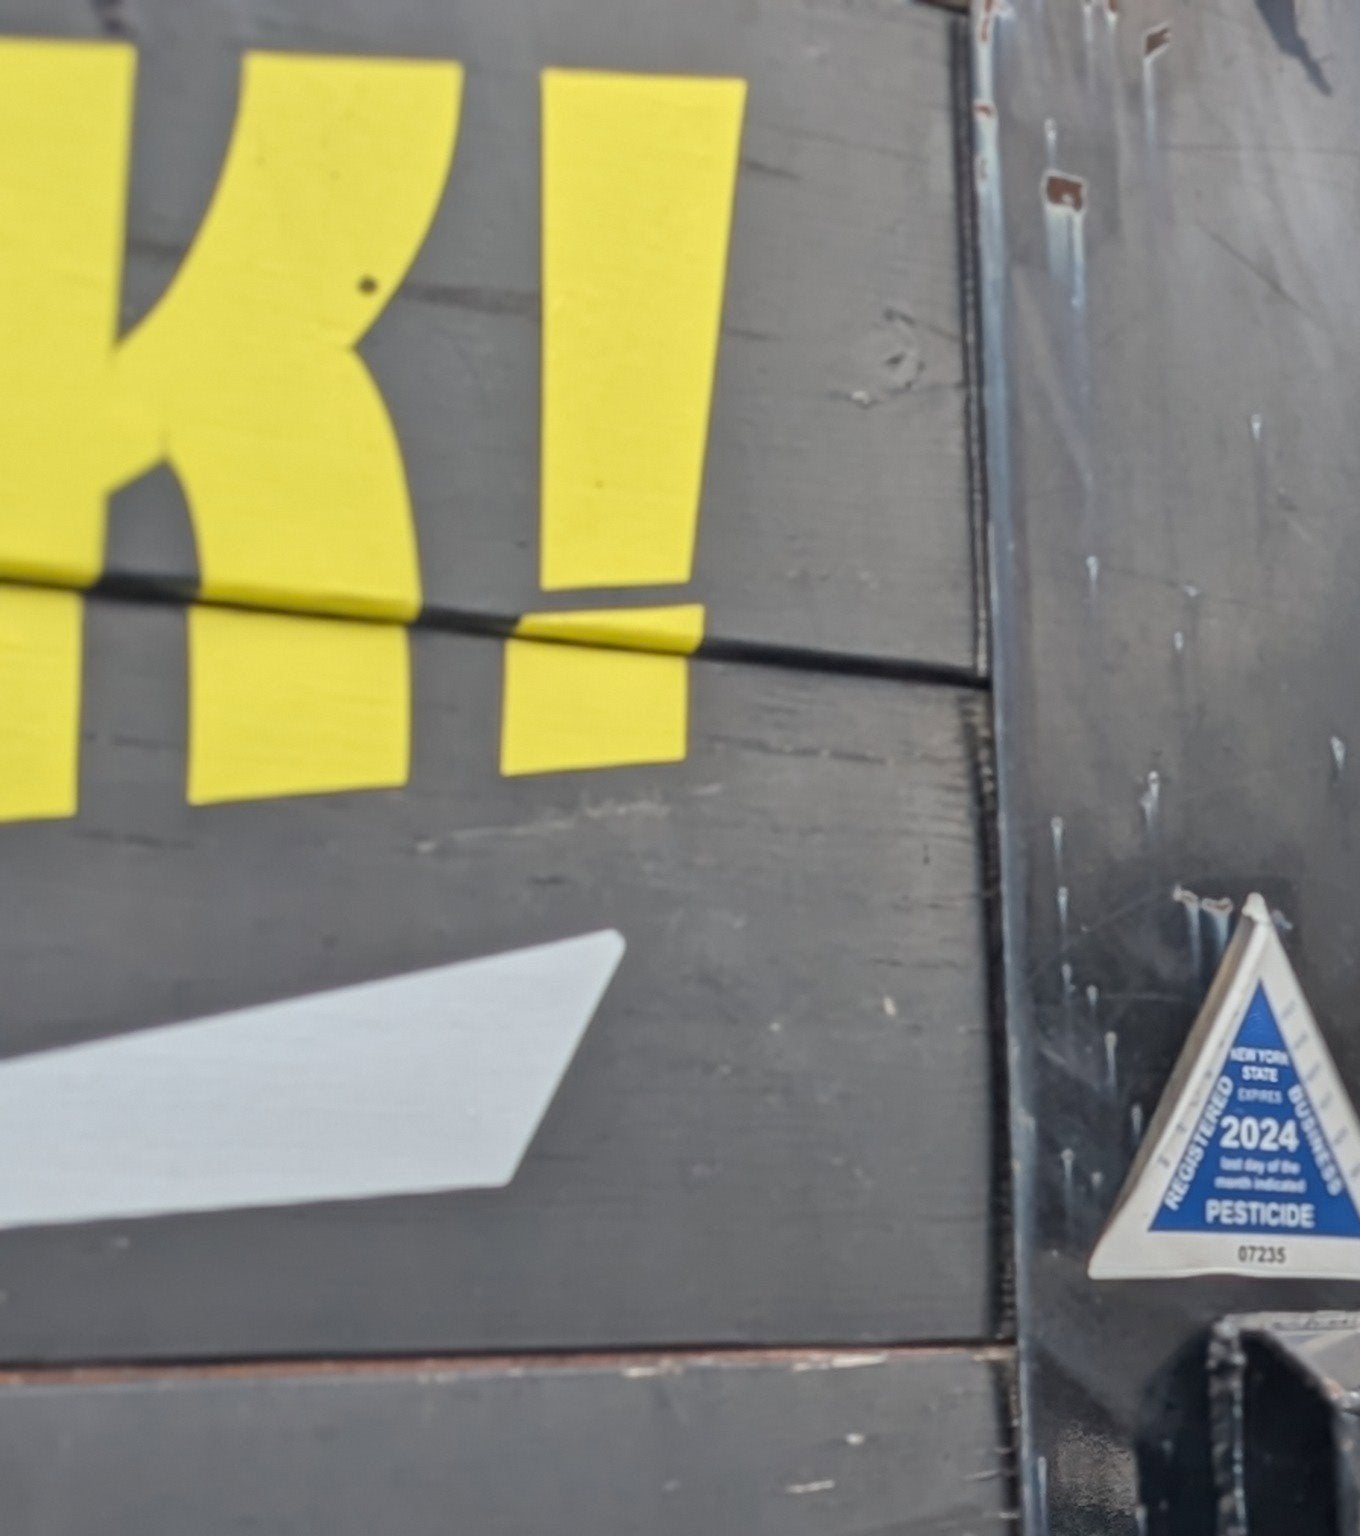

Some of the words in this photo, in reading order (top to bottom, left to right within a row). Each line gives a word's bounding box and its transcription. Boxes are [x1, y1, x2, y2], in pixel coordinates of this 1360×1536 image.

[1241, 1064, 1279, 1083] STATE
[1164, 1075, 1234, 1212] REGISTERED
[1219, 1114, 1300, 1153] 2024
[1287, 1083, 1343, 1197] BUSINESS
[1205, 1198, 1316, 1230] PESTICIDE
